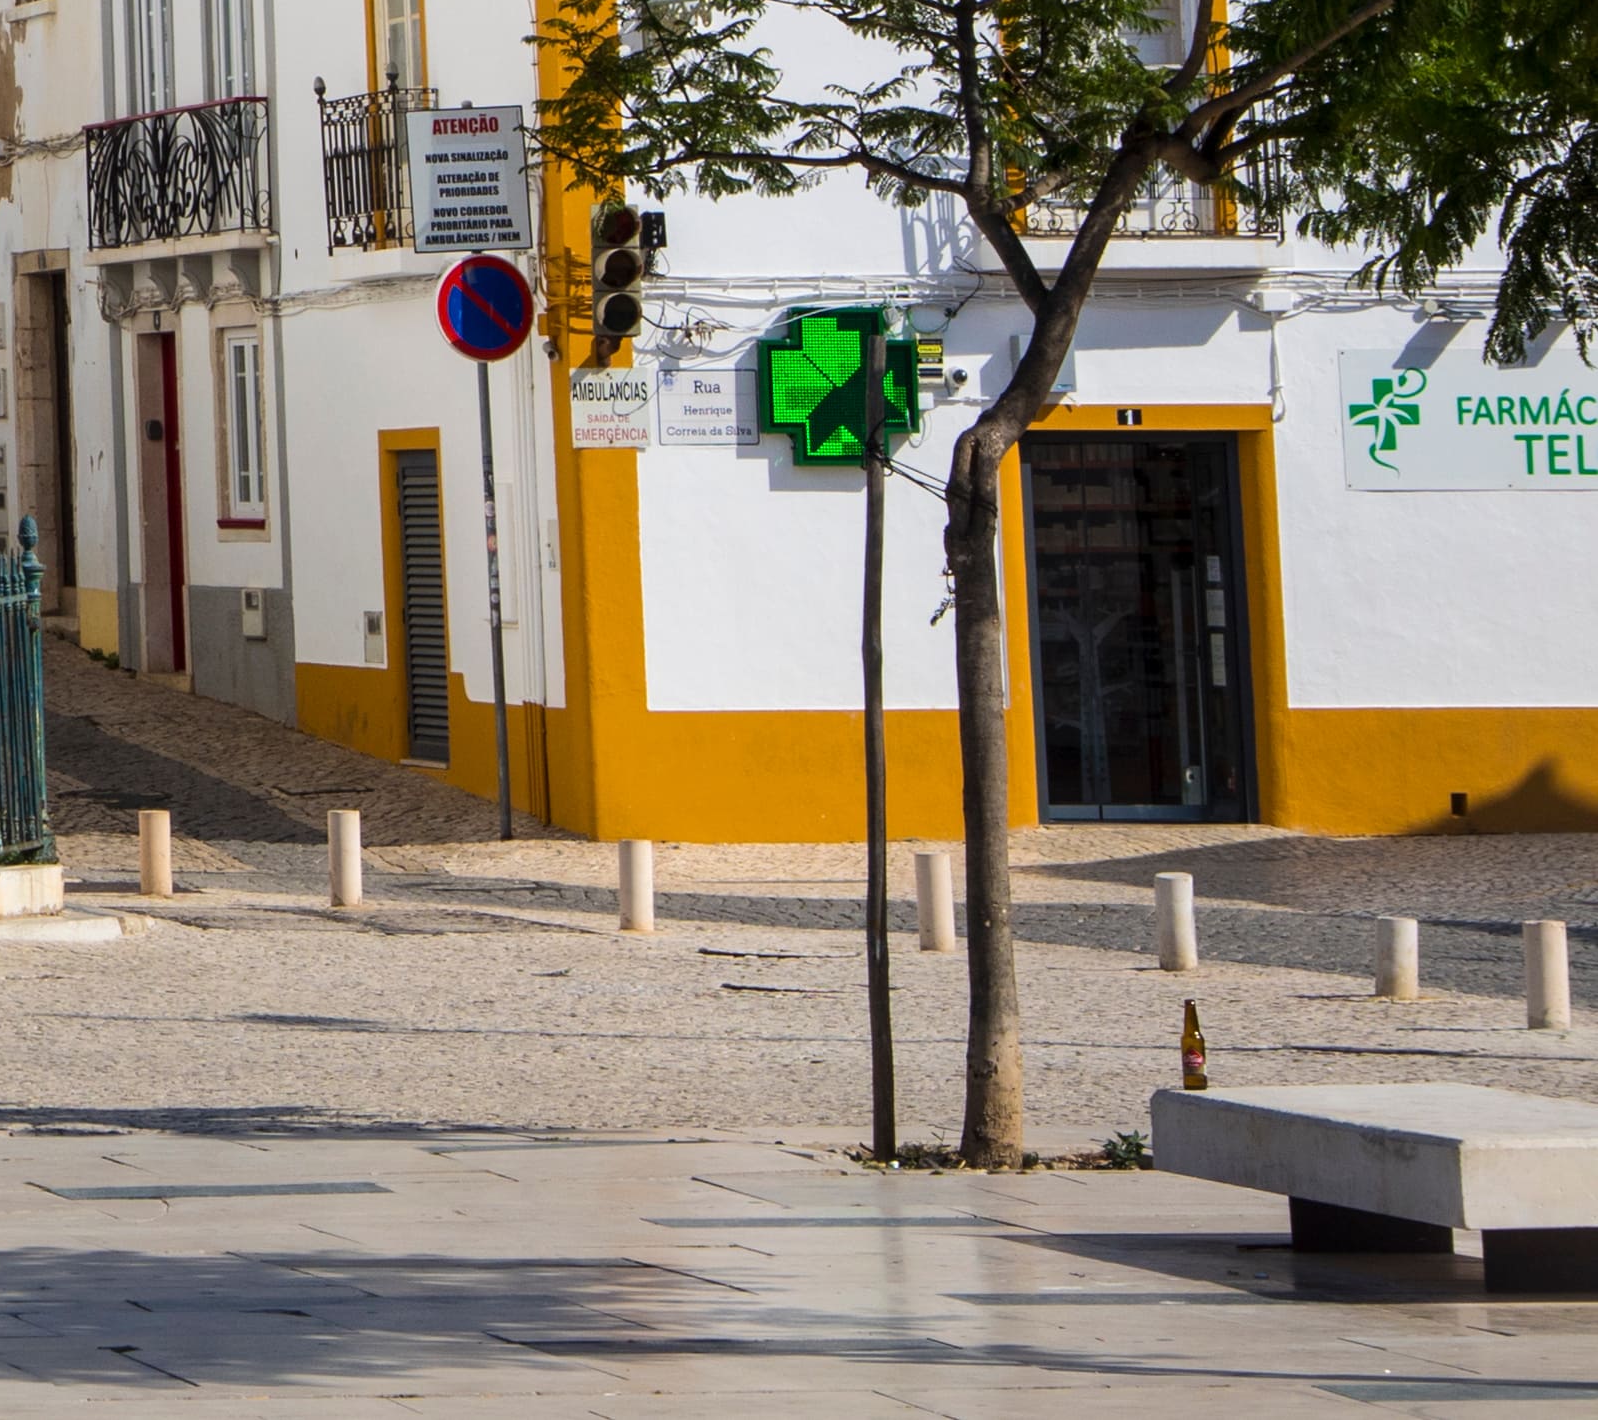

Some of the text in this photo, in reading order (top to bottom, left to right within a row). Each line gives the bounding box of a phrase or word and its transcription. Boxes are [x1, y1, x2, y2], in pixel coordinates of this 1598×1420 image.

[432, 113, 499, 136] ATENÇÃO
[425, 149, 508, 163] NOVA SINALIZAÇÃO
[437, 171, 499, 184] ALTERAÇÃO DE
[439, 185, 499, 197] PRIORIDADES
[433, 205, 508, 218] NOVO CORREDOR
[430, 218, 513, 231] PRIORITÁRIO PARA
[425, 231, 490, 245] AMBULÂNCIAS
[497, 231, 521, 242] INEM
[693, 380, 721, 394] Rua
[683, 405, 733, 418] Henrique
[1456, 388, 1598, 426] FARMÁC
[587, 412, 630, 423] SAÍDA DE
[1124, 409, 1134, 426] 1
[574, 424, 648, 441] EMERGÊNCIA
[666, 424, 752, 437] Correia da Silva
